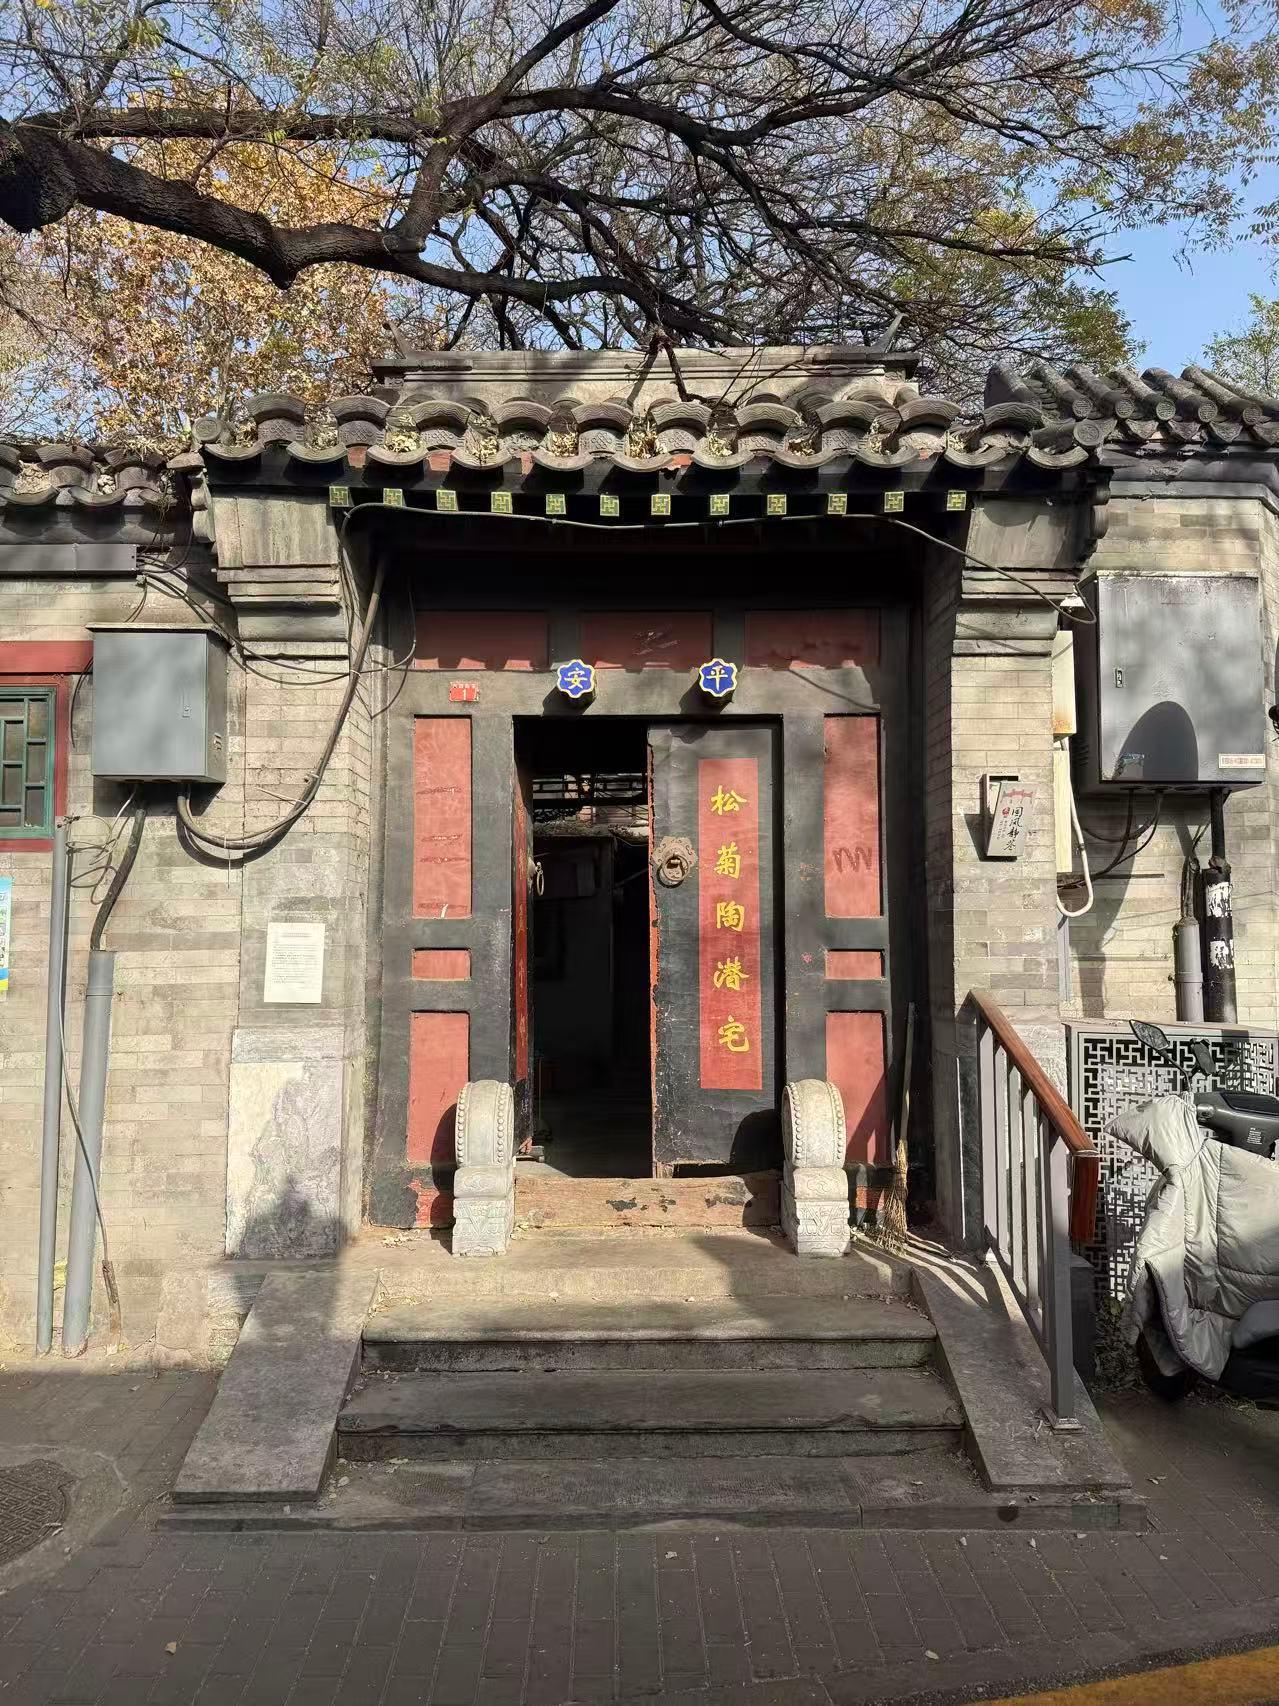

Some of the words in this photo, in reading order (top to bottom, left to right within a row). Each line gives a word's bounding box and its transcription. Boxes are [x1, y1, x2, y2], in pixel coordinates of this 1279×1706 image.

[564, 667, 588, 689] 安
[706, 665, 728, 691] 平
[462, 688, 467, 701] 1
[710, 784, 750, 1053] 松菊陶潜宅
